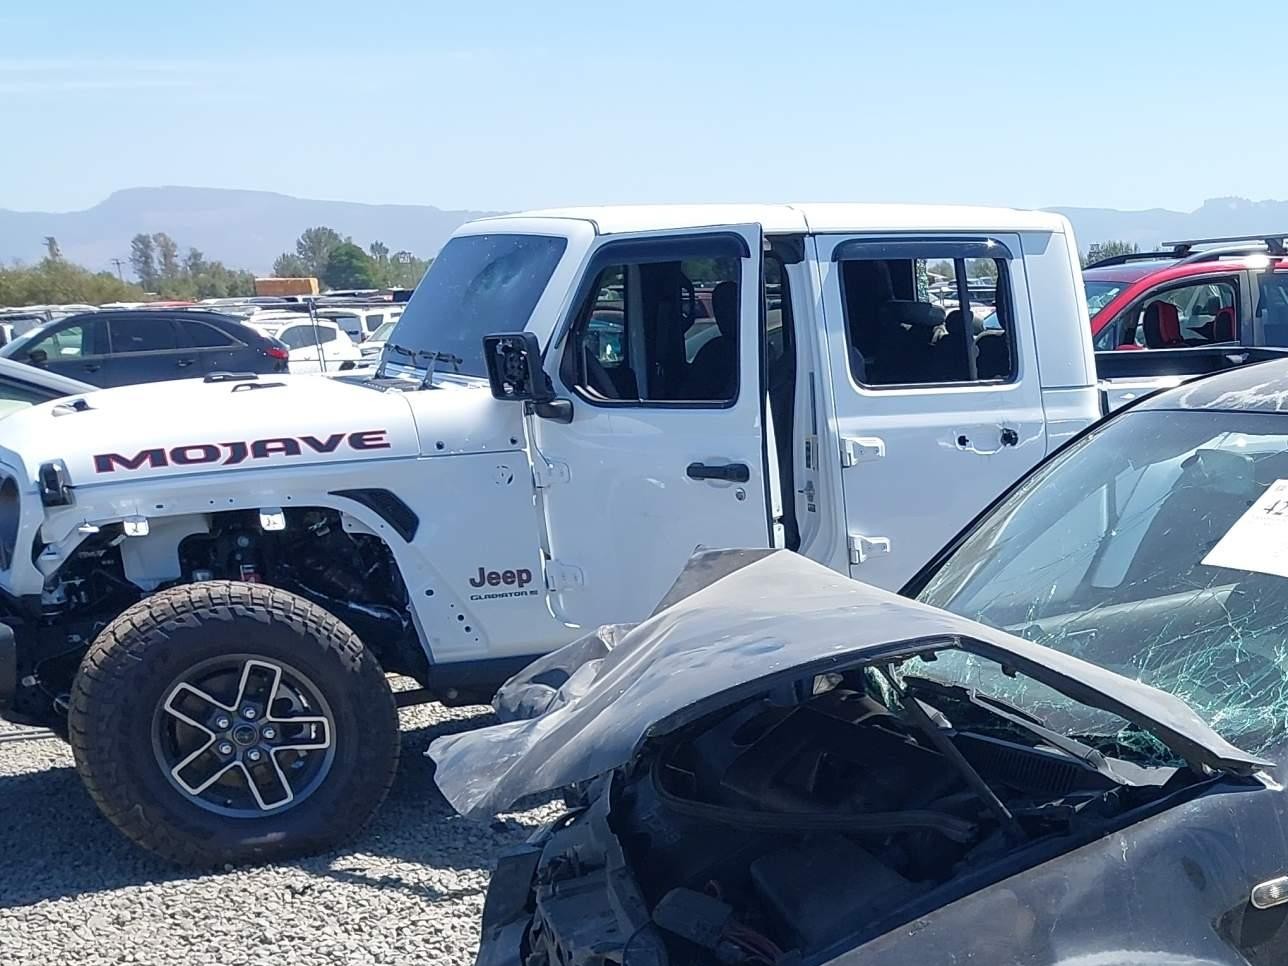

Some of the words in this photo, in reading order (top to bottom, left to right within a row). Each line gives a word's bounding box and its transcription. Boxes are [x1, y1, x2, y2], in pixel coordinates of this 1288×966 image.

[94, 430, 391, 474] MOJAVE
[469, 567, 532, 588] Jeep
[470, 590, 528, 601] GLADIATOR
